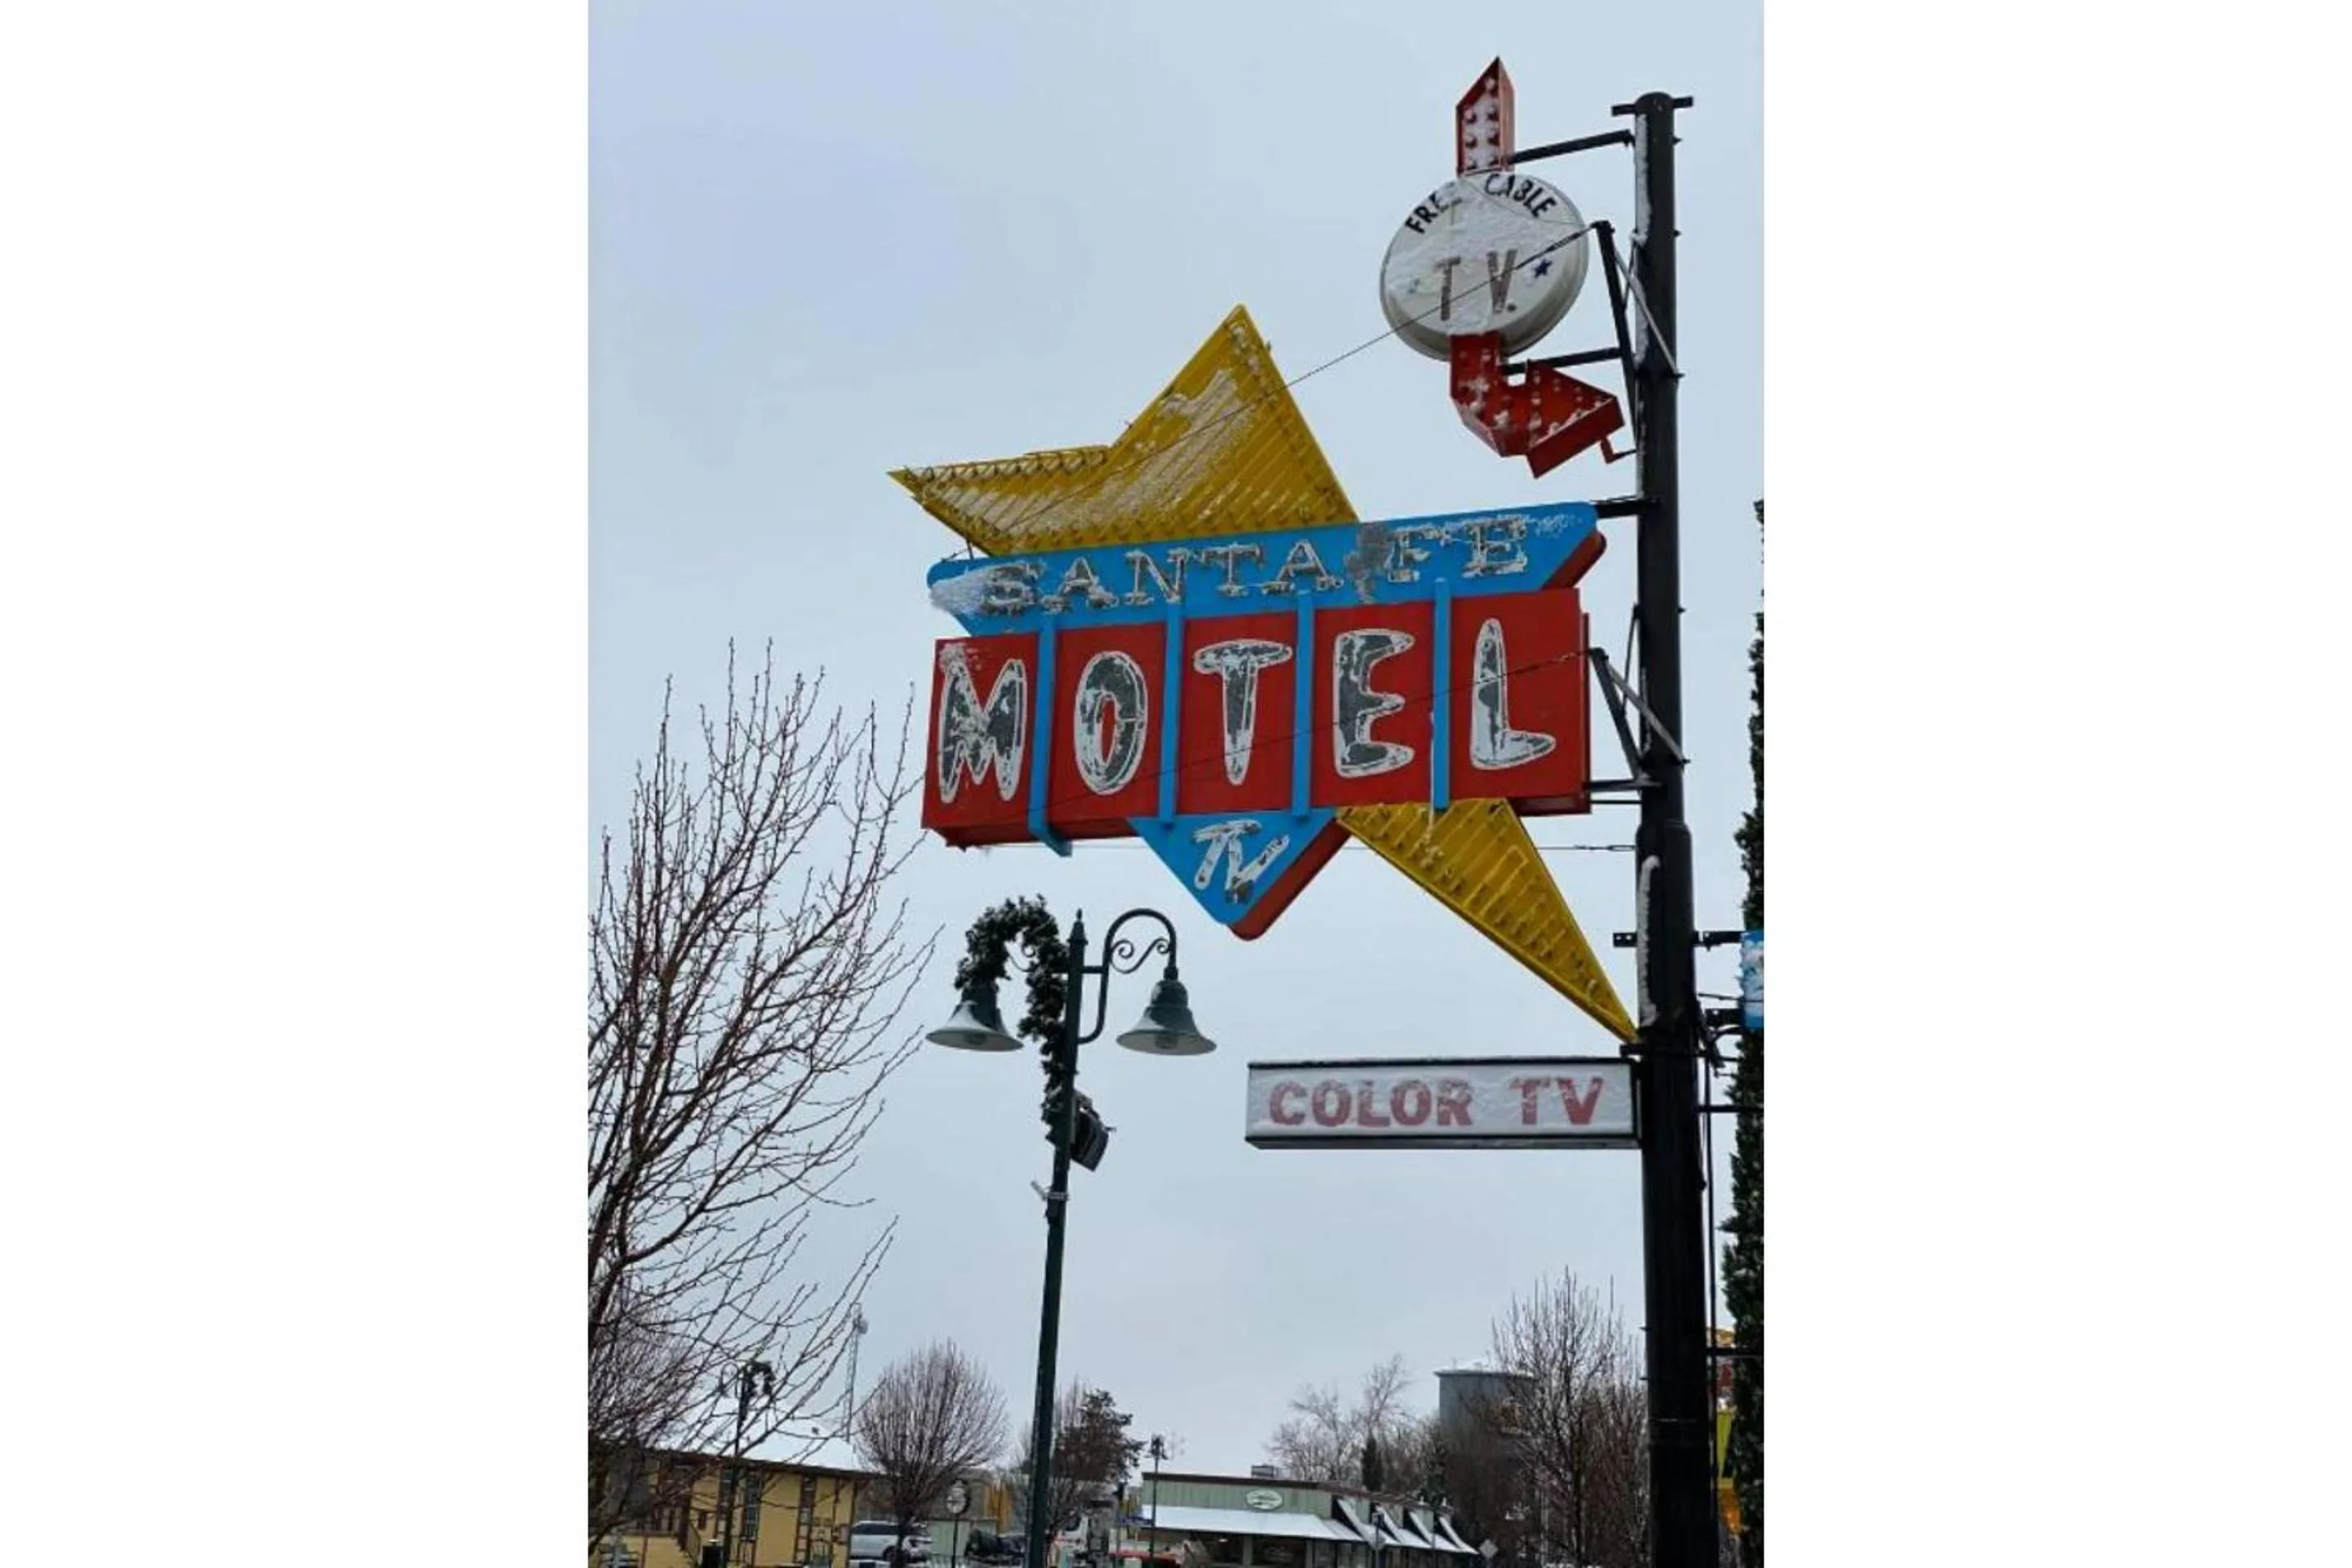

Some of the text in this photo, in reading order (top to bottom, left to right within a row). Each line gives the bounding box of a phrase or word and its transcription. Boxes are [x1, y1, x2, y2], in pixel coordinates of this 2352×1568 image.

[1483, 172, 1557, 219] CABLE
[980, 514, 1528, 617] SANTA FE
[937, 618, 1556, 804] MOTEL
[1193, 819, 1291, 904] TV
[1268, 1076, 1605, 1128] COLOR TV
